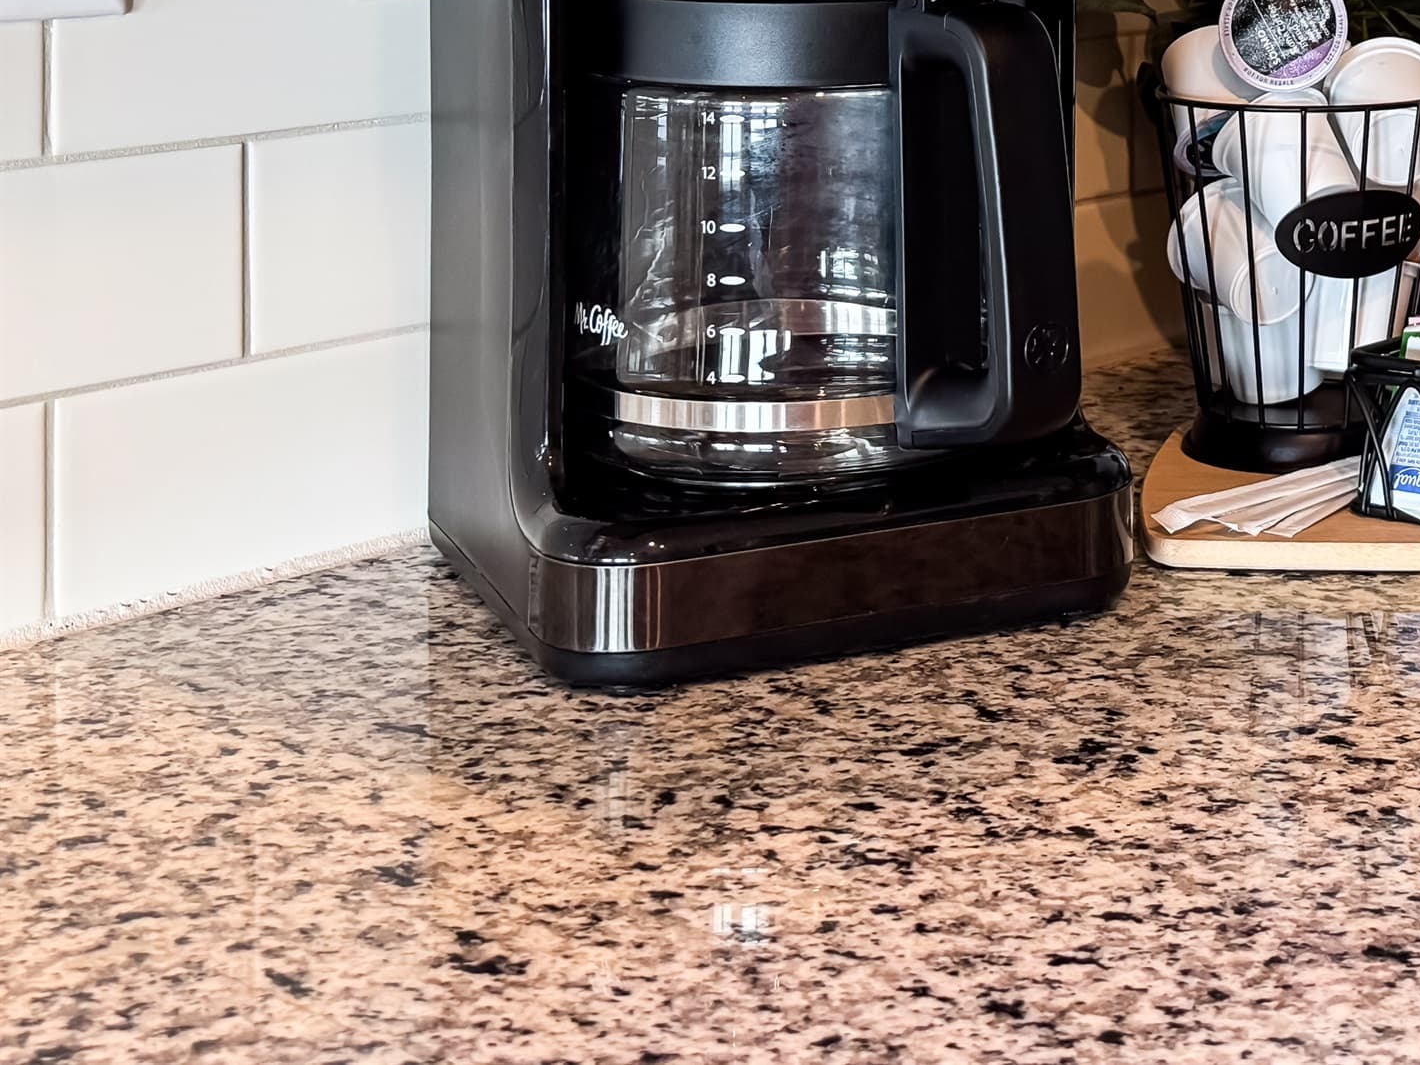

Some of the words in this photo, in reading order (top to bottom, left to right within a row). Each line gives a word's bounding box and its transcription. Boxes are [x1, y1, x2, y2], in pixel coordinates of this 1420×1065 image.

[700, 112, 716, 125] 14
[700, 167, 717, 180] 12
[700, 221, 717, 234] 10
[706, 274, 716, 287] 8
[589, 304, 629, 346] Coffee
[706, 325, 716, 338] 6
[706, 371, 716, 384] 4
